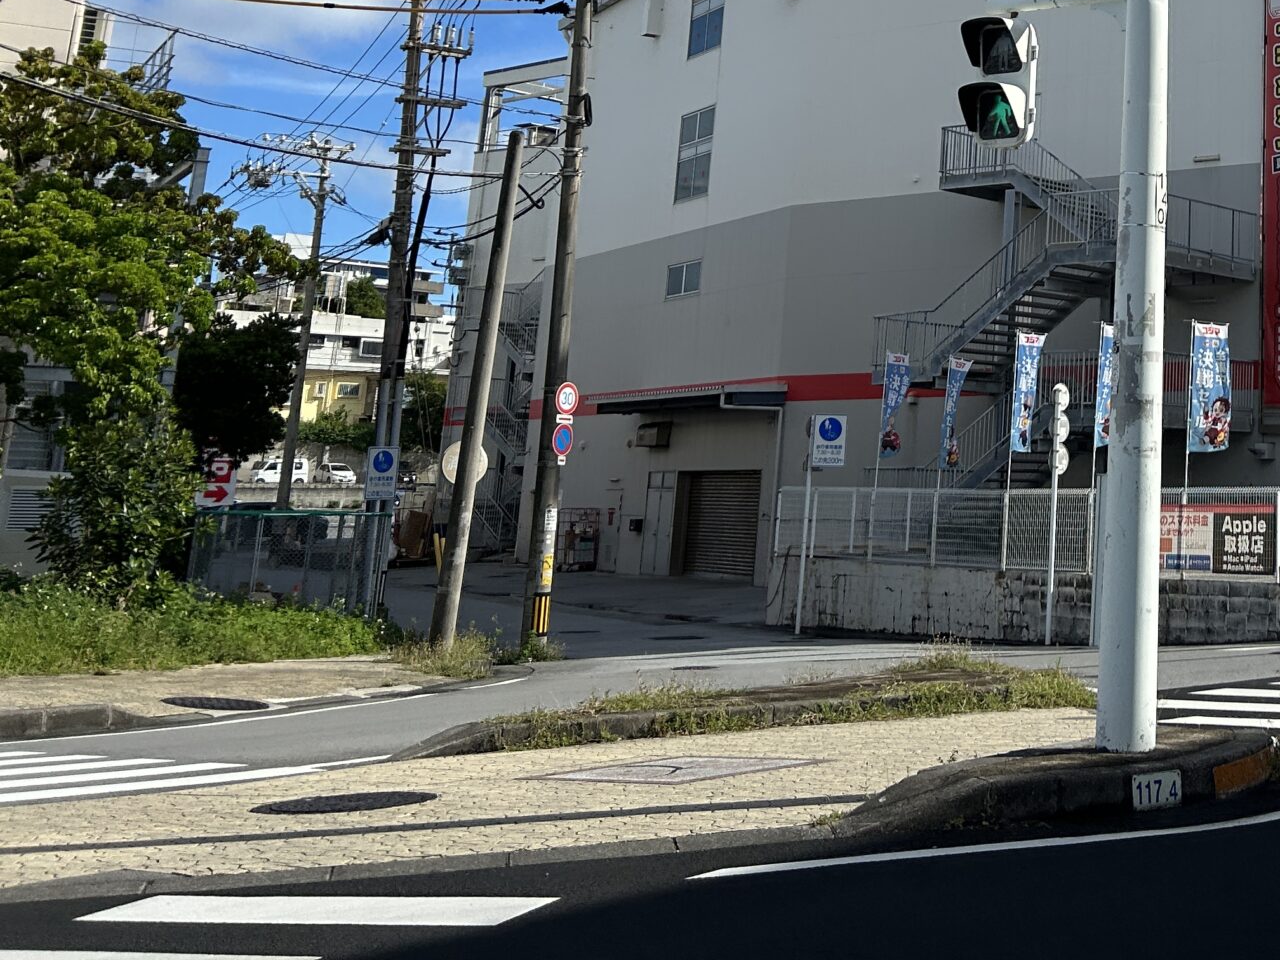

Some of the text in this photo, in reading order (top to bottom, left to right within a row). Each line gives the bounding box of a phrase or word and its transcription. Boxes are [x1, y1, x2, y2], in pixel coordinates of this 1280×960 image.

[561, 391, 573, 406] 30
[1222, 515, 1267, 534] Apple
[1224, 535, 1264, 554] 取扱店
[1136, 780, 1179, 805] 117.4
